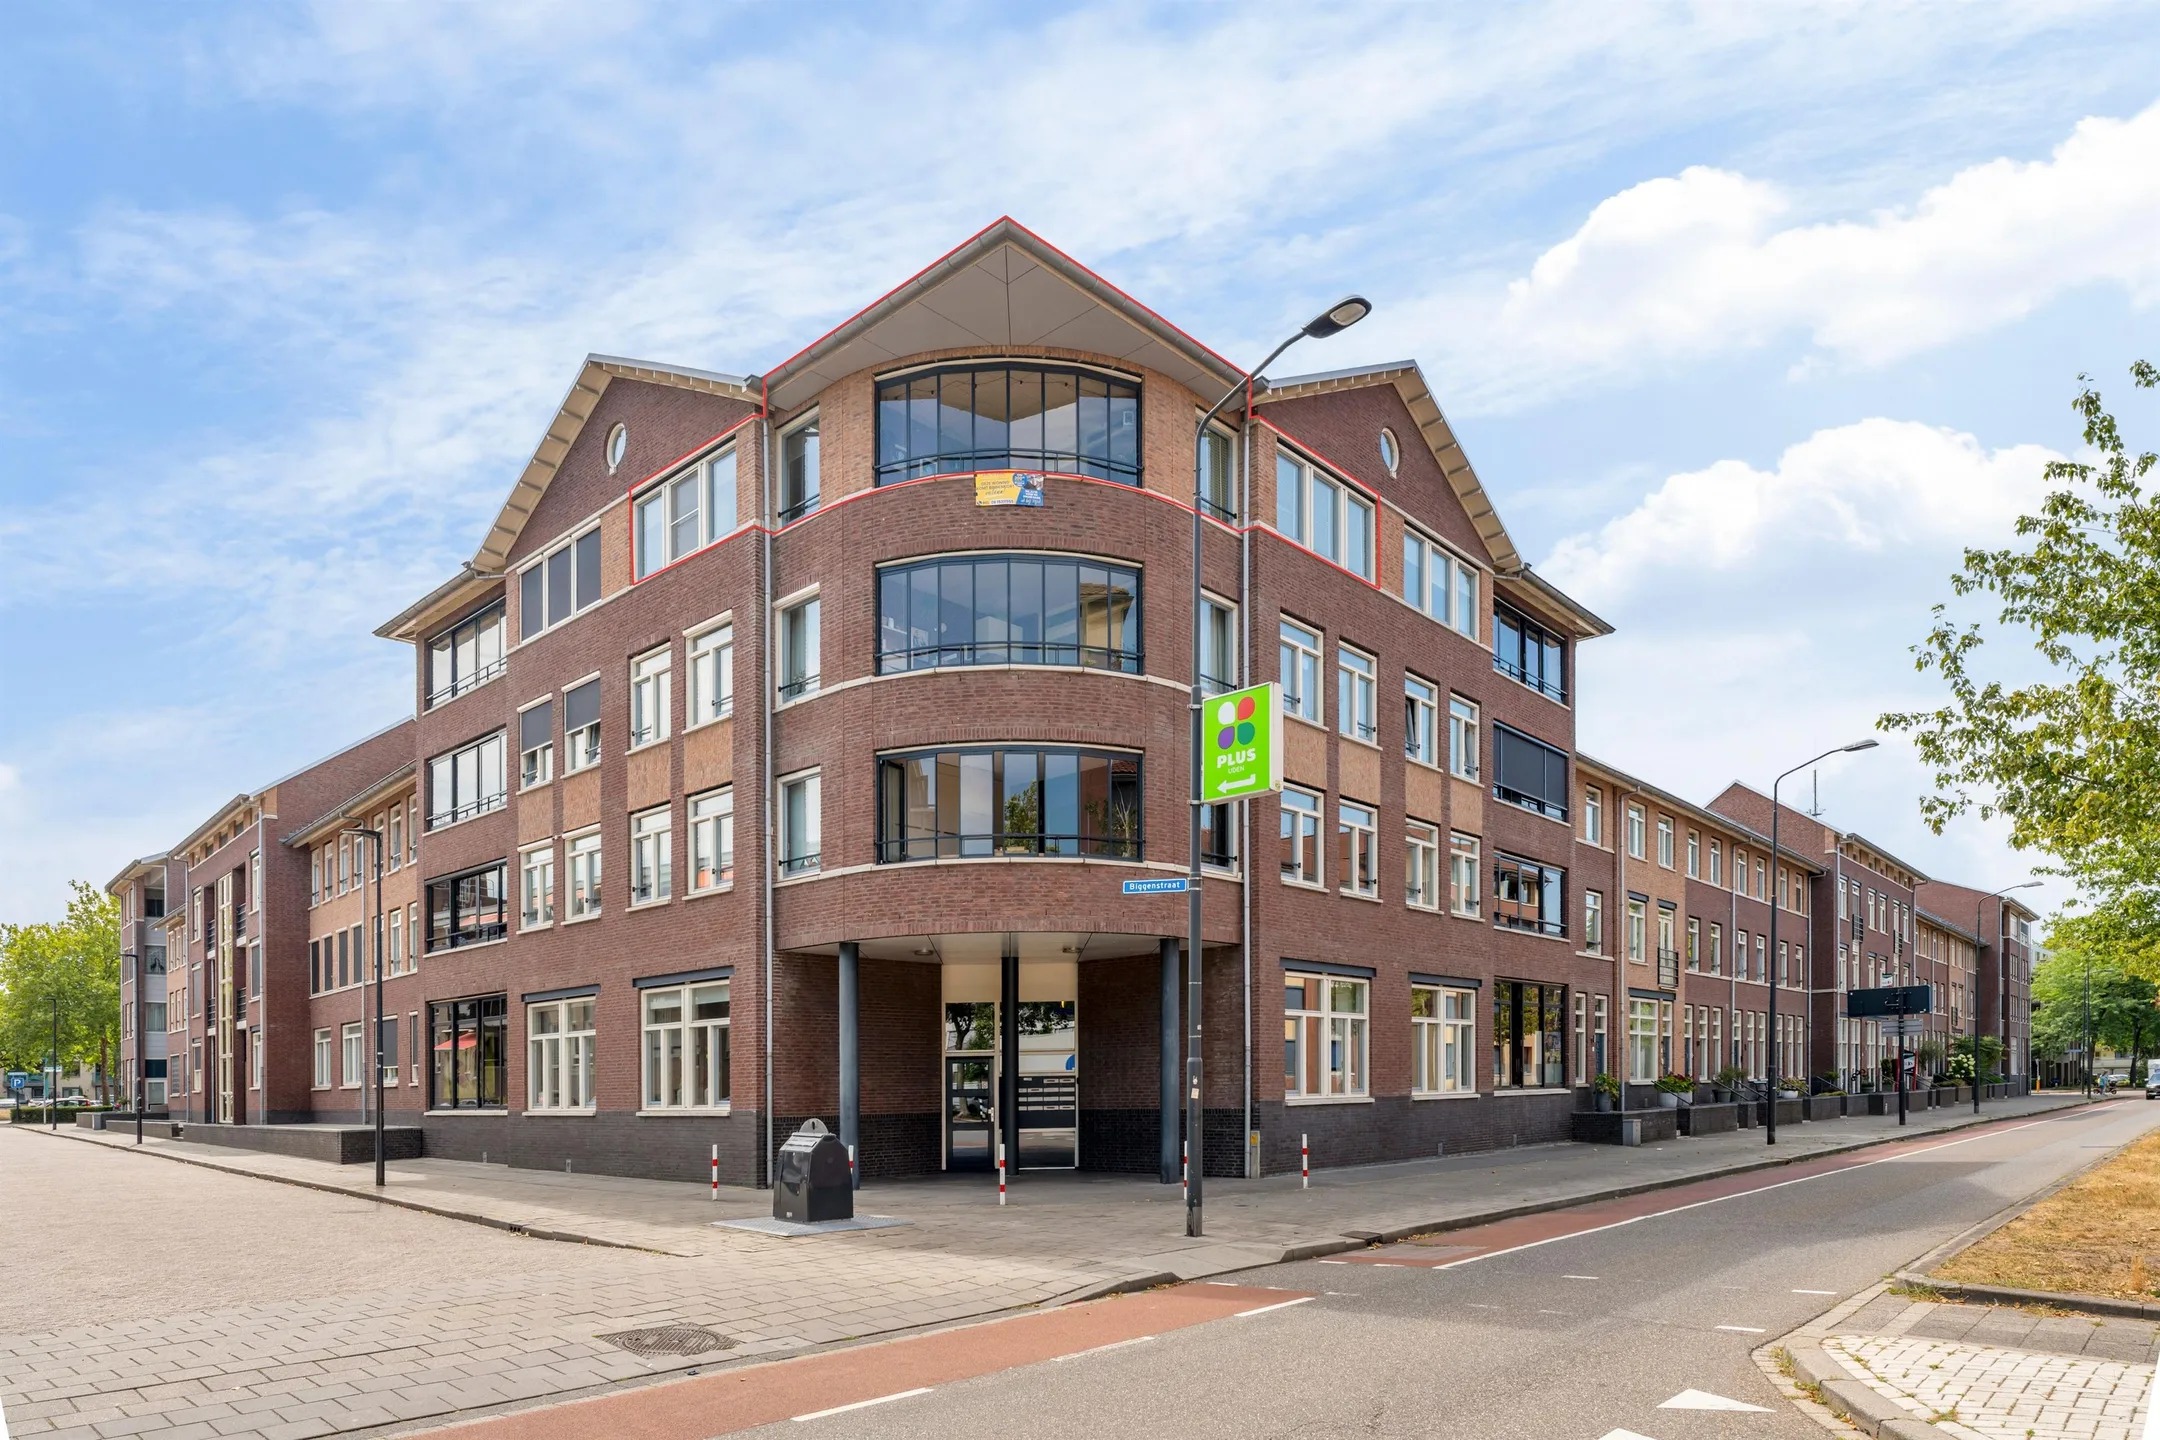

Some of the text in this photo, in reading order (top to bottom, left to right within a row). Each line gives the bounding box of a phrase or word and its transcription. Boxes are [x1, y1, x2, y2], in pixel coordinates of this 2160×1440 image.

[1217, 748, 1256, 768] PLUS
[1228, 765, 1245, 774] UDEN
[1129, 881, 1180, 891] Biggenstraat
